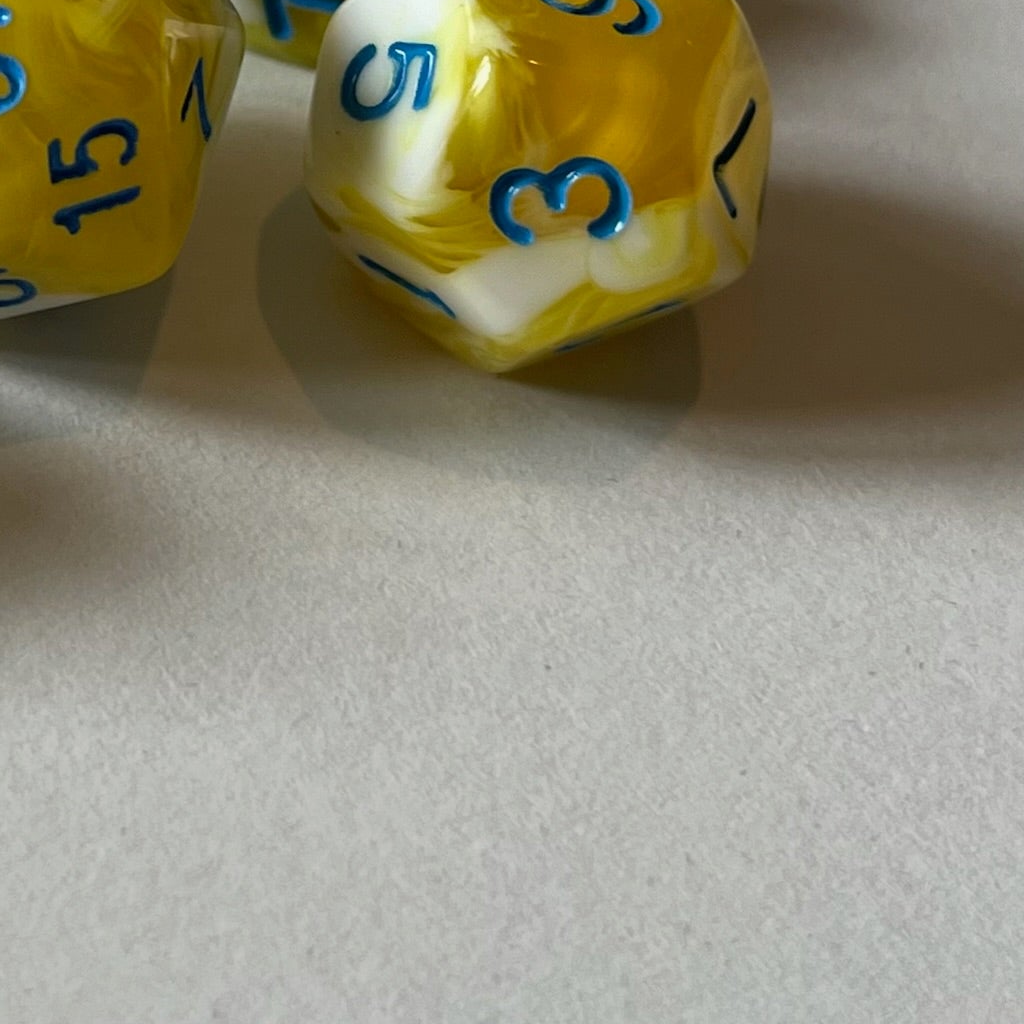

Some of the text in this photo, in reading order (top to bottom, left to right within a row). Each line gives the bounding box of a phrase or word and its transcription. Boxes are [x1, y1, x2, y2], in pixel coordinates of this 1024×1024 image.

[339, 41, 438, 123] 5
[46, 117, 141, 235] 15
[489, 155, 634, 247] 3
